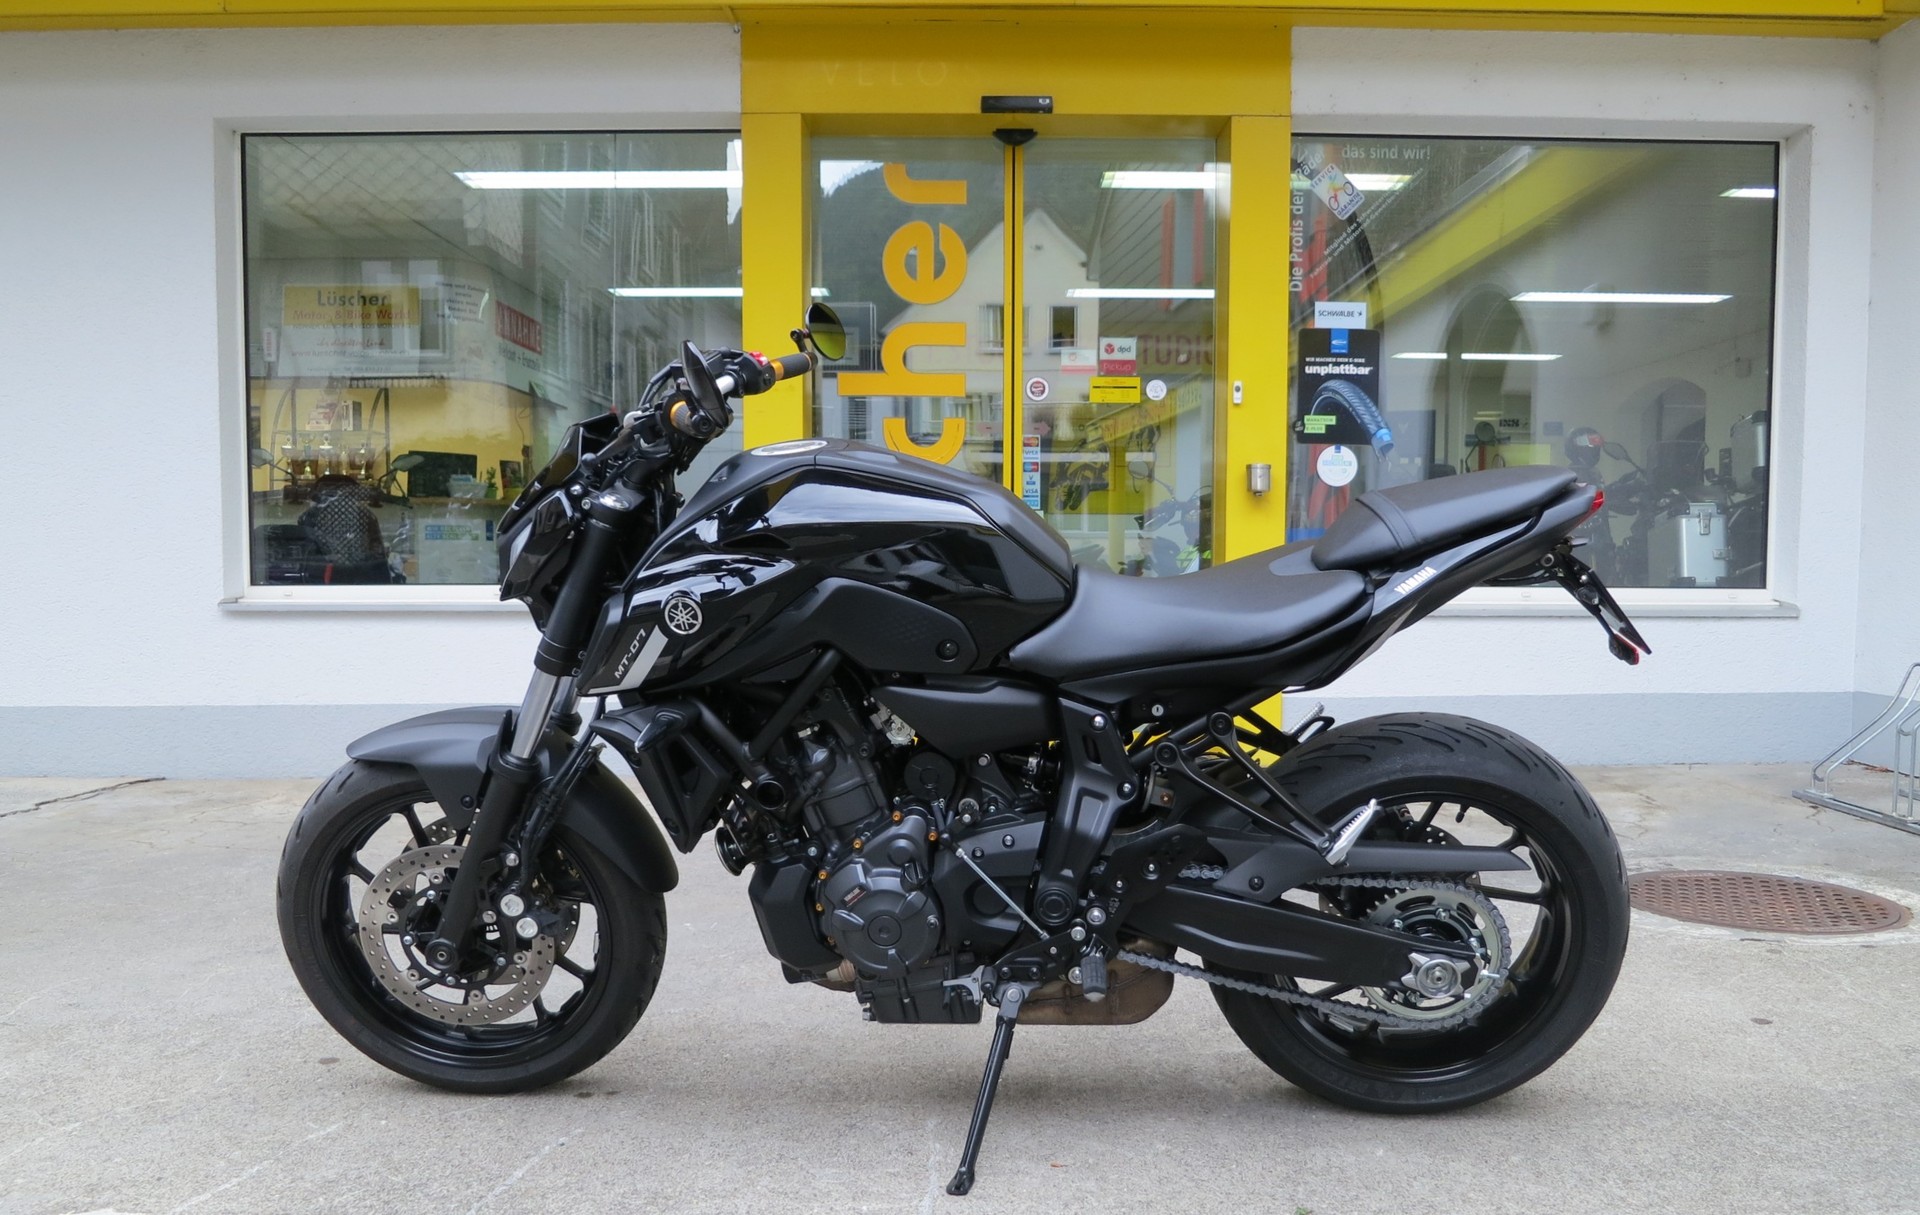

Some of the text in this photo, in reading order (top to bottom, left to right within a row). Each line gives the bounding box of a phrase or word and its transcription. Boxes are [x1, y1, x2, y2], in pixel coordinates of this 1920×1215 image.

[1341, 144, 1431, 160] das sind wir!
[1311, 164, 1335, 189] SERVICE
[1289, 190, 1304, 292] Die Profis der
[1323, 231, 1348, 256] Mitglied
[1346, 222, 1358, 234] des
[1333, 246, 1345, 258] und
[317, 289, 388, 307] Lüscher
[1317, 309, 1355, 318] SCHWALBE
[1116, 344, 1132, 355] dpd
[1103, 360, 1133, 372] Pickup
[1304, 363, 1372, 377] unplattbar
[1025, 487, 1039, 495] VISA
[1393, 565, 1438, 595] YAMAHA
[613, 627, 647, 680] MT-07
